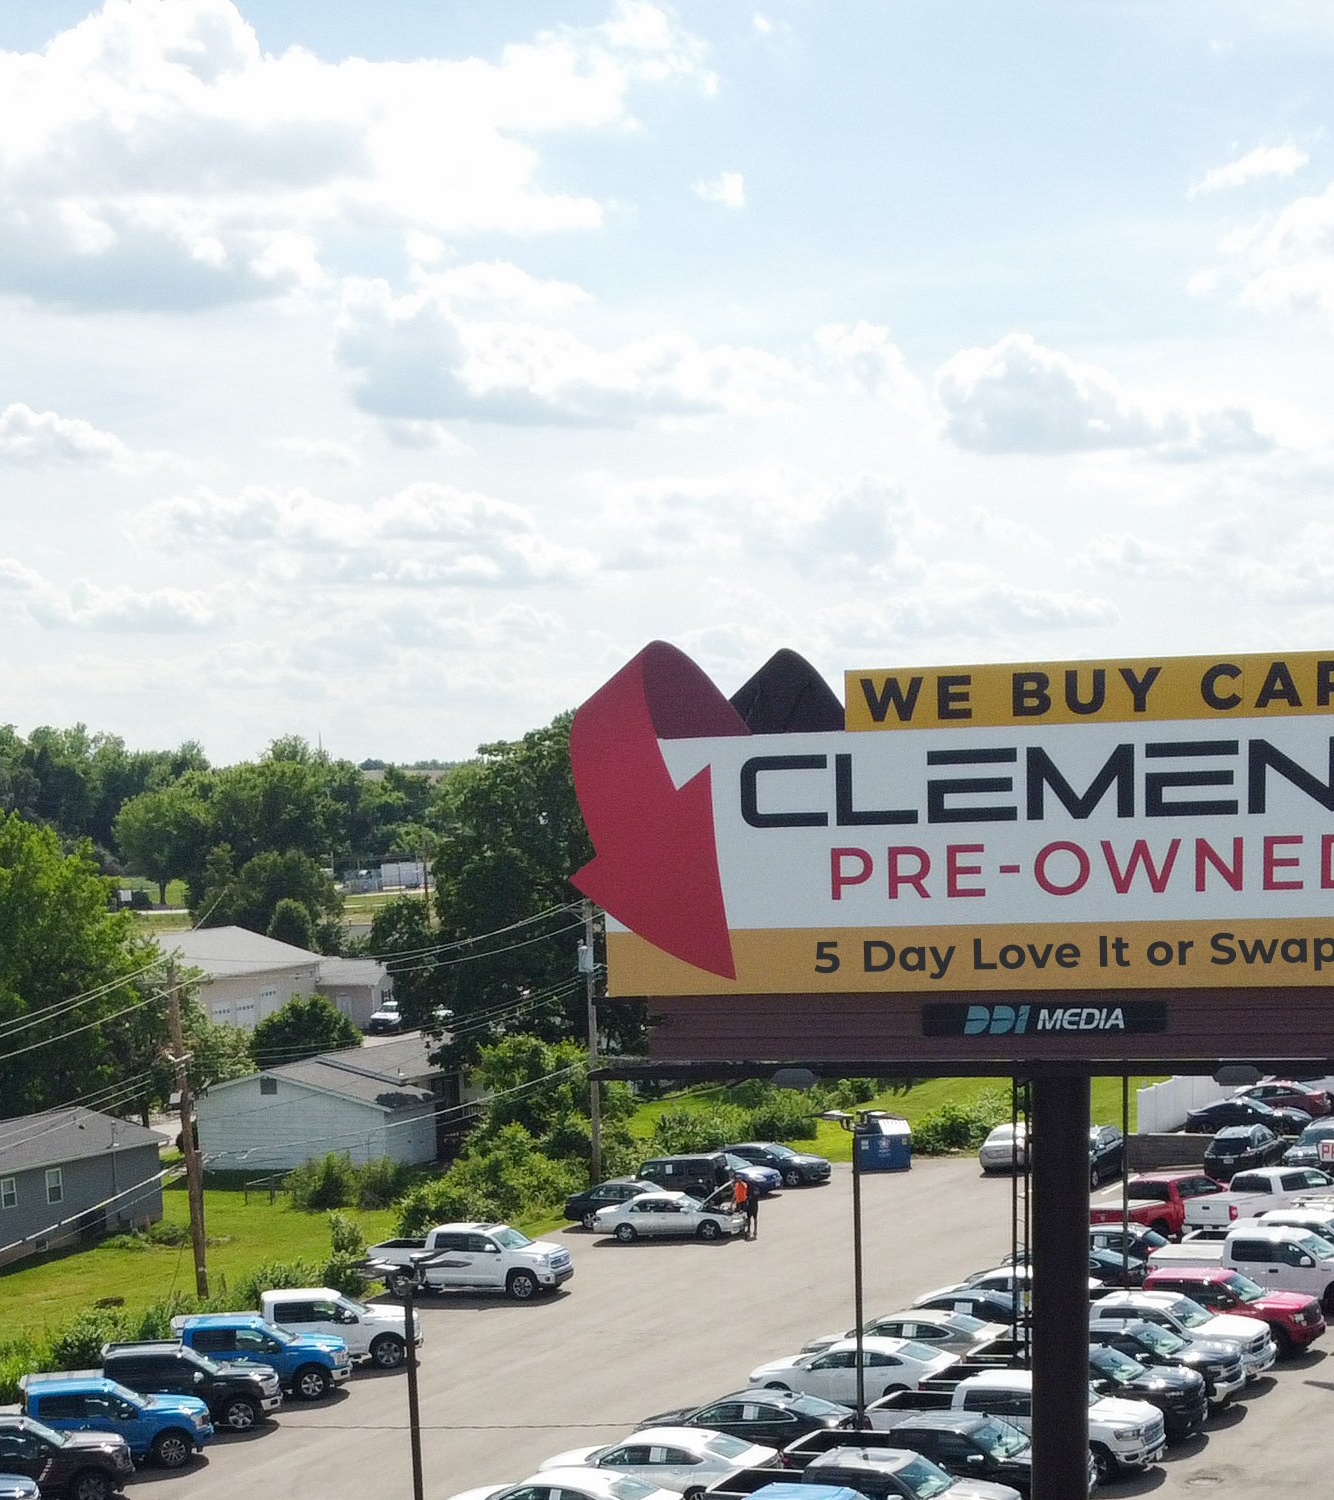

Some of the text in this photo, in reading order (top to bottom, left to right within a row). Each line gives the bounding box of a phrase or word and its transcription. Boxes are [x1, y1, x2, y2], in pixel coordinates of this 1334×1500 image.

[860, 675, 972, 723] WE
[1011, 666, 1162, 717] BUY
[813, 941, 841, 974] 5
[863, 940, 956, 980] Day
[973, 937, 1082, 971] Love
[1099, 936, 1130, 968] It
[1146, 938, 1194, 967] or
[1037, 1008, 1125, 1030] MEDIA
